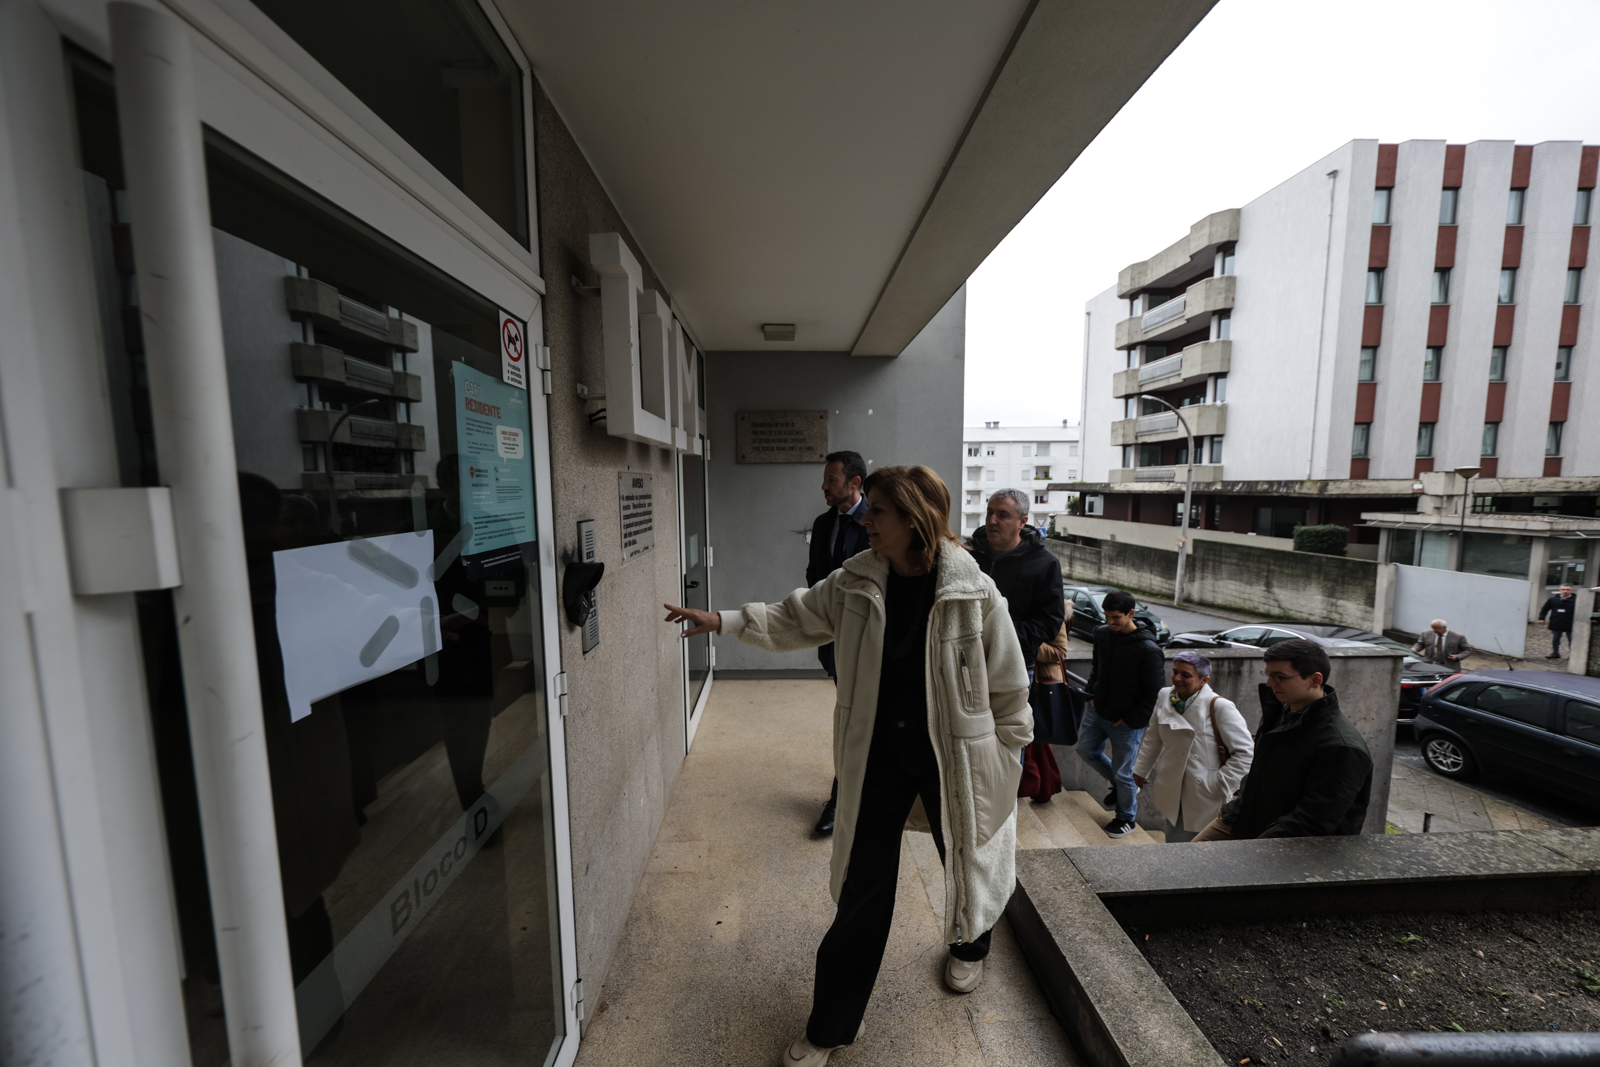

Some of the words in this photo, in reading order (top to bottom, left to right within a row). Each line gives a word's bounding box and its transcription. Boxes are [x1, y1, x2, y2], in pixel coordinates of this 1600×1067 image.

[465, 396, 501, 419] RESIDENTE
[632, 477, 644, 488] AVISO
[390, 836, 467, 936] Bloco
[474, 806, 488, 841] D
